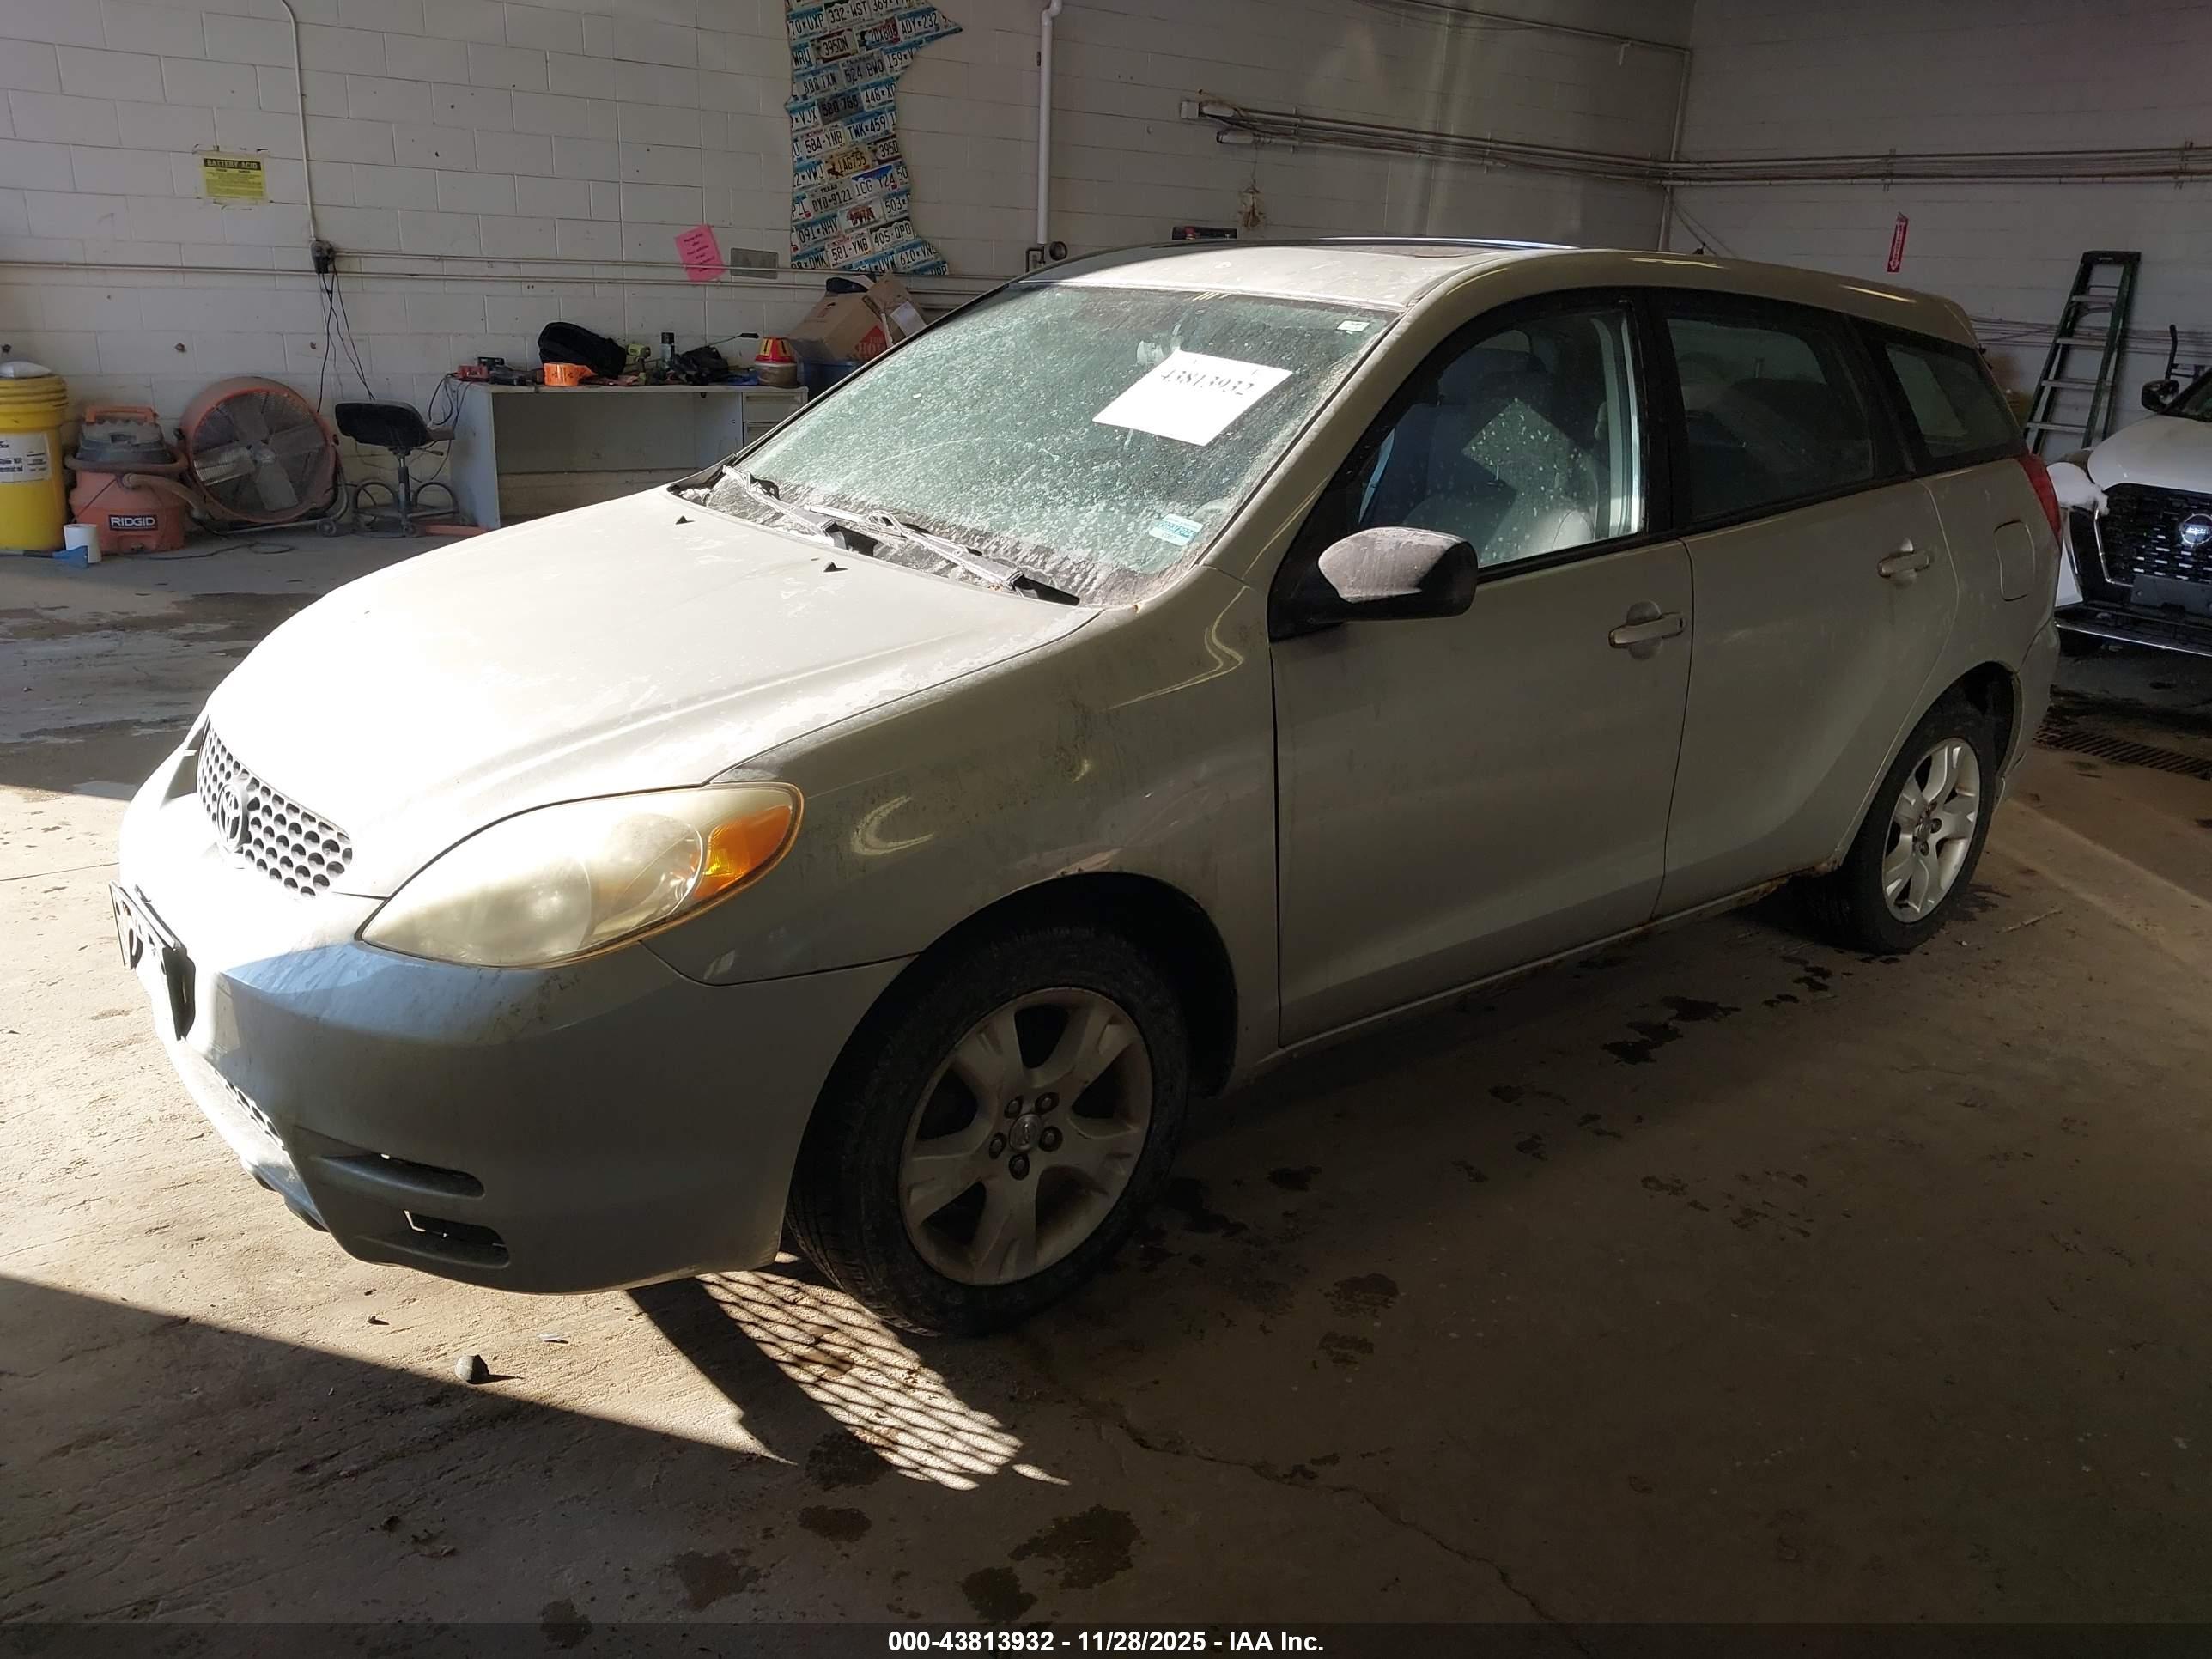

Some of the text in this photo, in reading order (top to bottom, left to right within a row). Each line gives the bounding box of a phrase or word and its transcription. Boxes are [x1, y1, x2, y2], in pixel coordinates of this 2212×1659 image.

[921, 12, 938, 29] 232
[870, 116, 886, 132] 459
[206, 159, 238, 168] BATTERY
[111, 517, 155, 526] RIDGID
